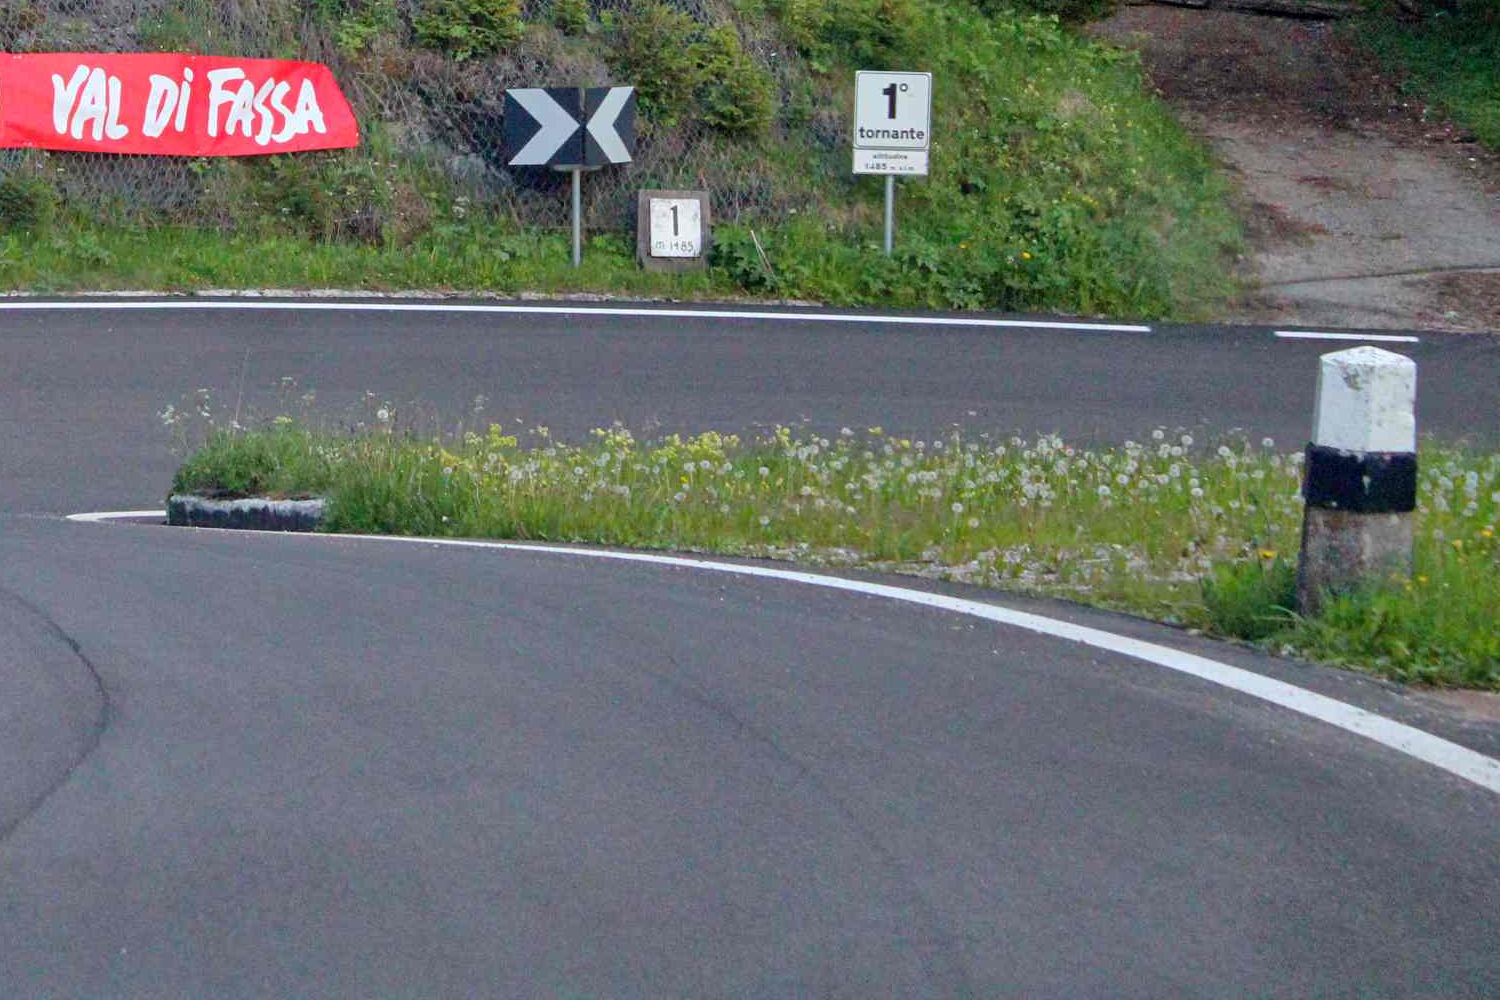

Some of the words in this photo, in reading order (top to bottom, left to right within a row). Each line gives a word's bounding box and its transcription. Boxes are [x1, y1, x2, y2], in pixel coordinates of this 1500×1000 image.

[52, 63, 129, 141] VAL
[141, 67, 194, 138] Di
[206, 67, 327, 146] FASSA
[859, 127, 924, 140] tornante
[670, 204, 679, 236] 1
